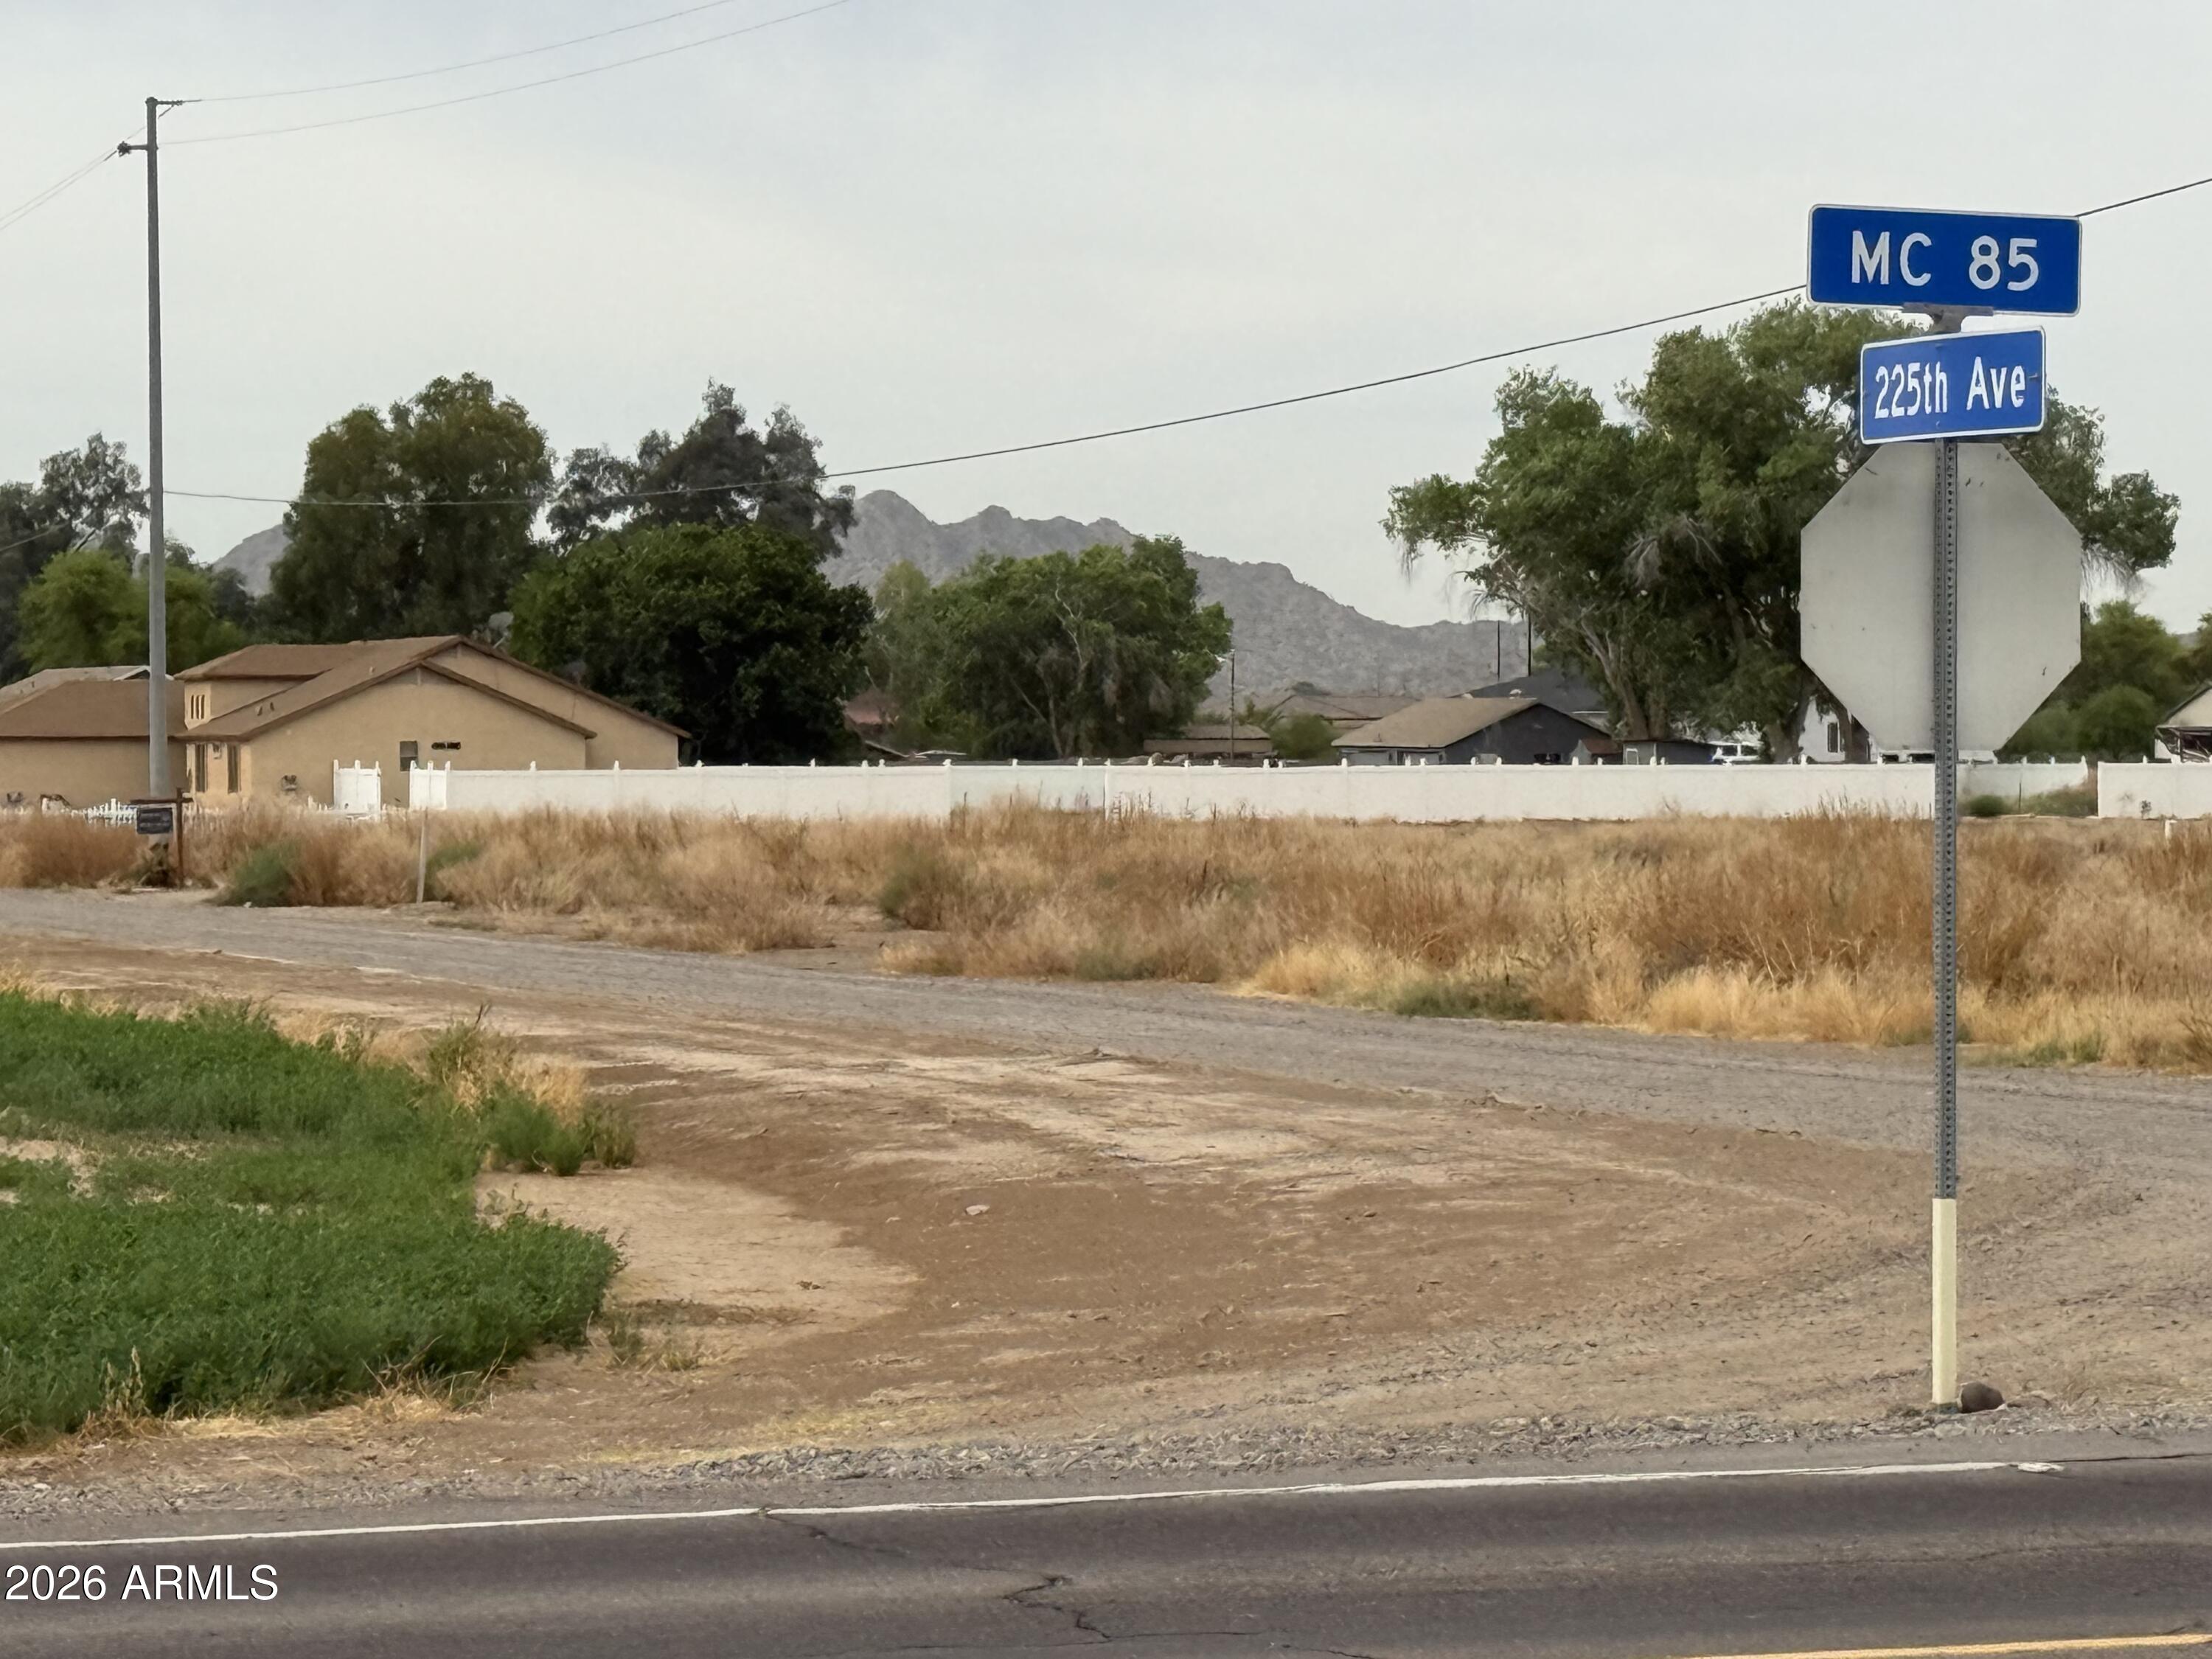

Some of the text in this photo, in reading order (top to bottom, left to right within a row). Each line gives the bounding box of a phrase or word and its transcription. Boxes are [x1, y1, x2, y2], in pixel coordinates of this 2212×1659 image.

[1851, 230, 2039, 292] MC 85
[1874, 357, 2026, 419] 225th Ave
